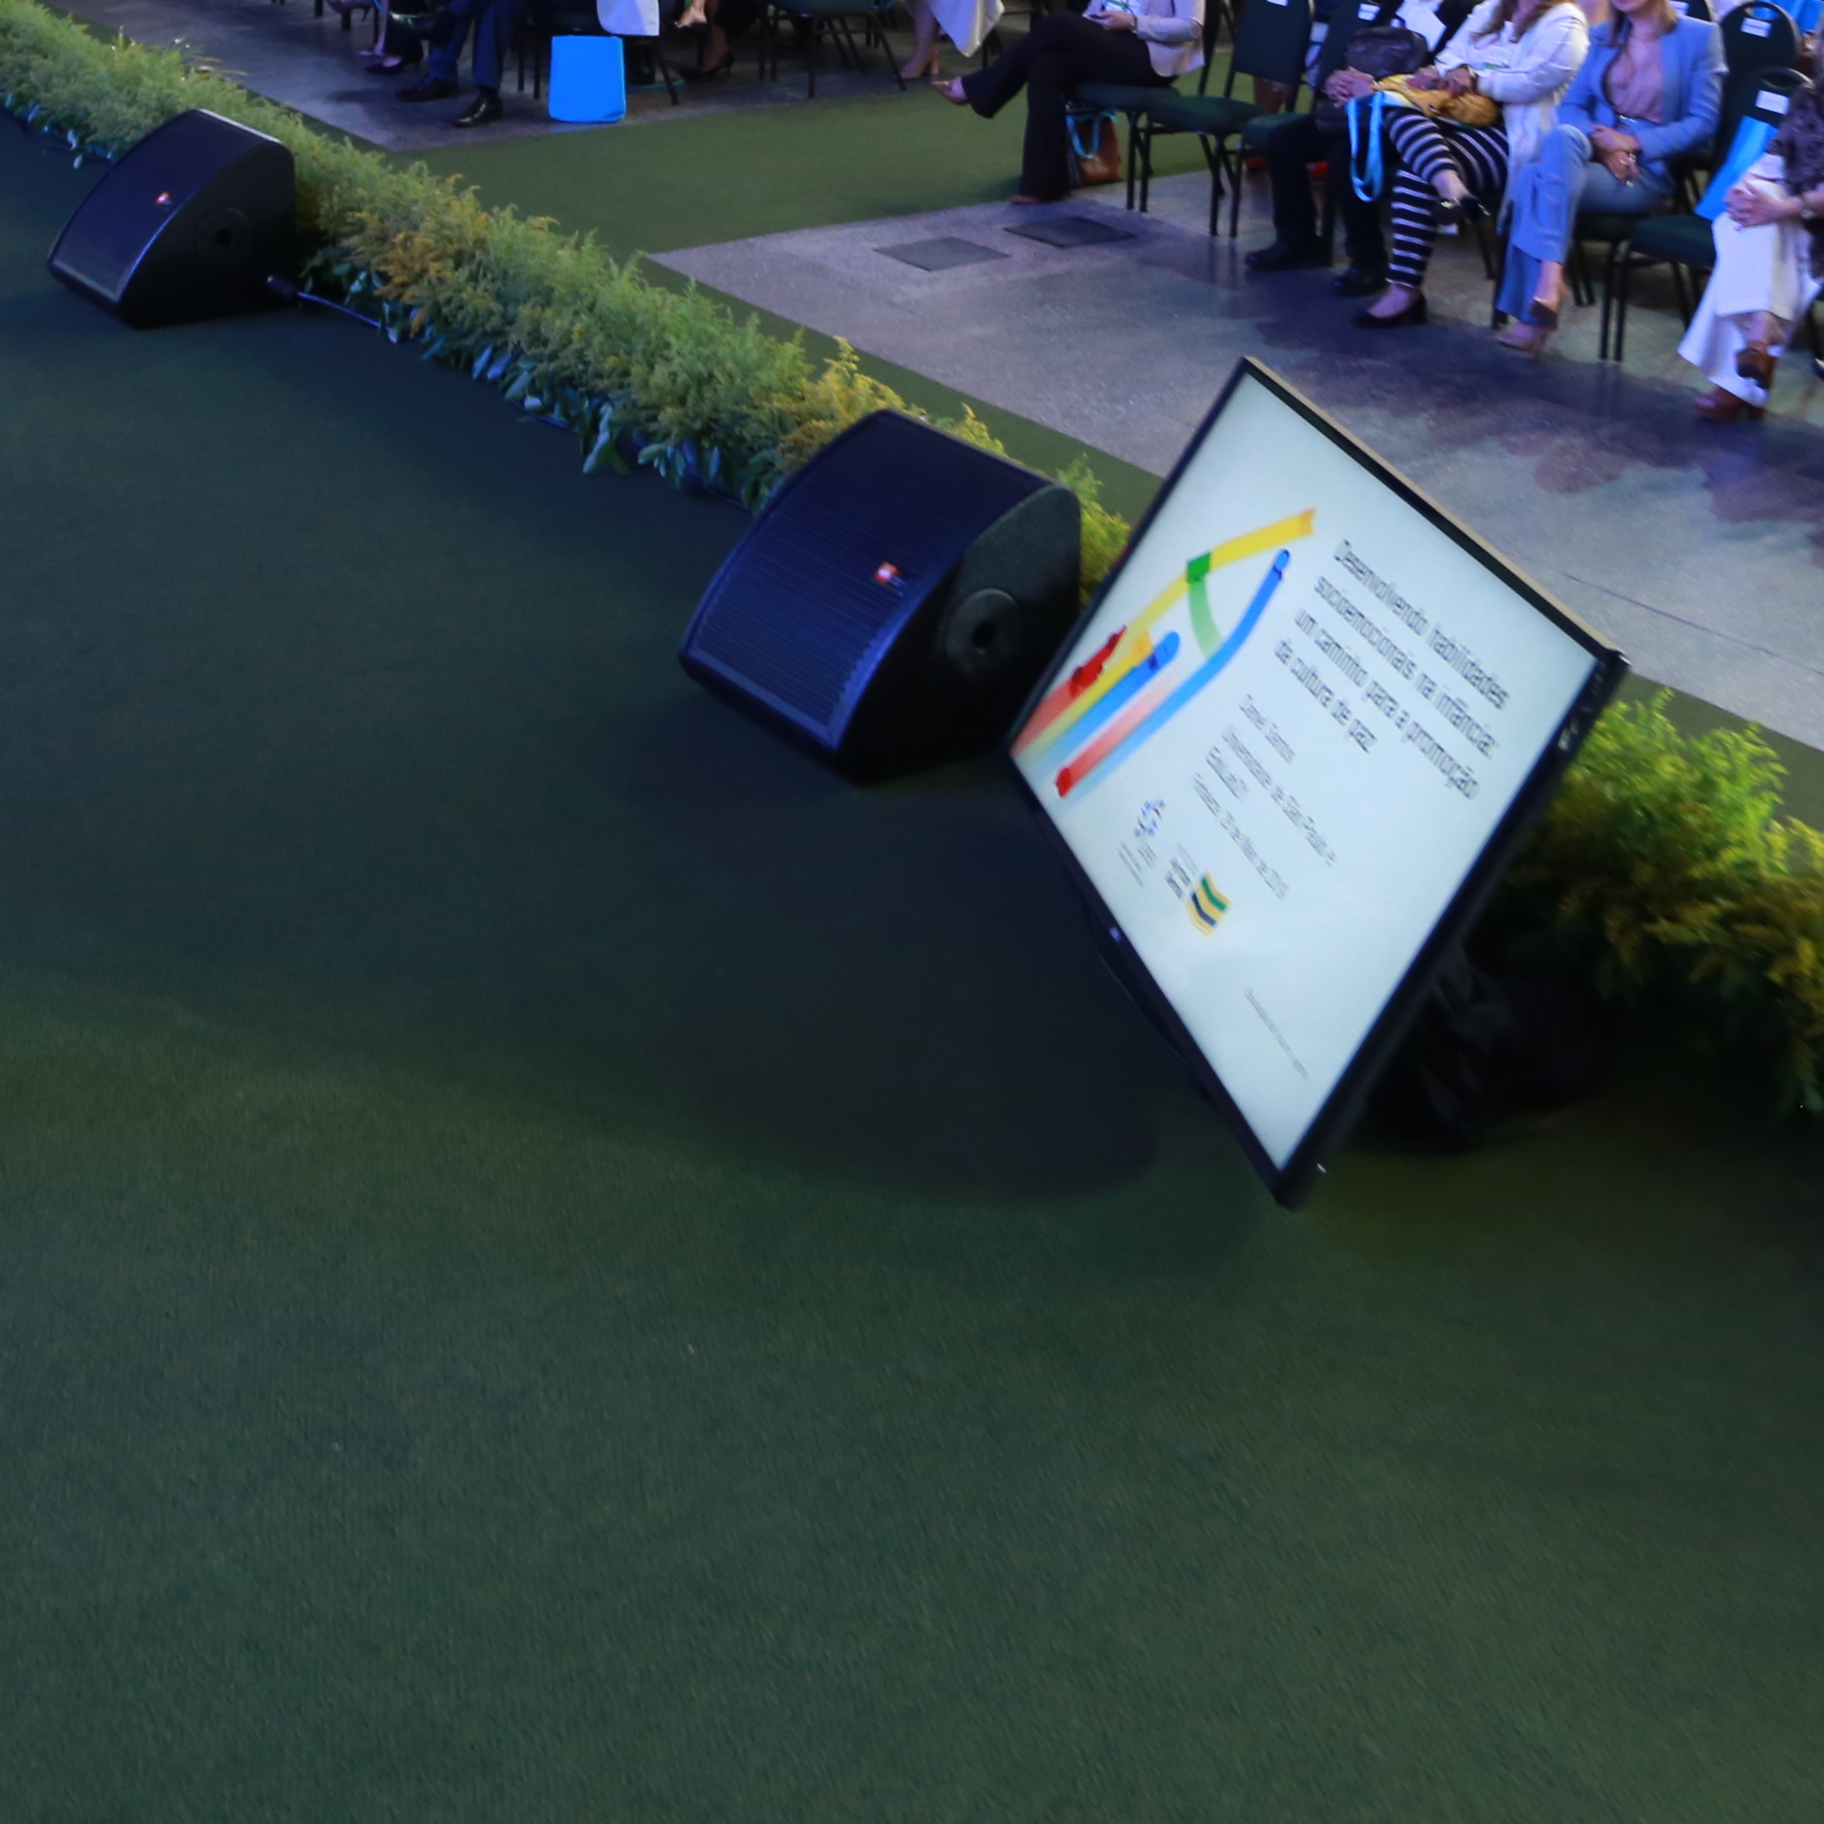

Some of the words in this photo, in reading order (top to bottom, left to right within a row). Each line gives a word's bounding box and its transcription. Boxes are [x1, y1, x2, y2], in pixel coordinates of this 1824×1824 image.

[1312, 572, 1420, 681] socioemocionais
[1332, 538, 1431, 636] Desenvolvendo
[1427, 624, 1512, 710] habilidades
[1289, 653, 1336, 709] cultura
[1345, 716, 1377, 757] paz
[1312, 624, 1370, 688] caminho
[1362, 677, 1400, 722] para
[1401, 717, 1481, 803] promoção
